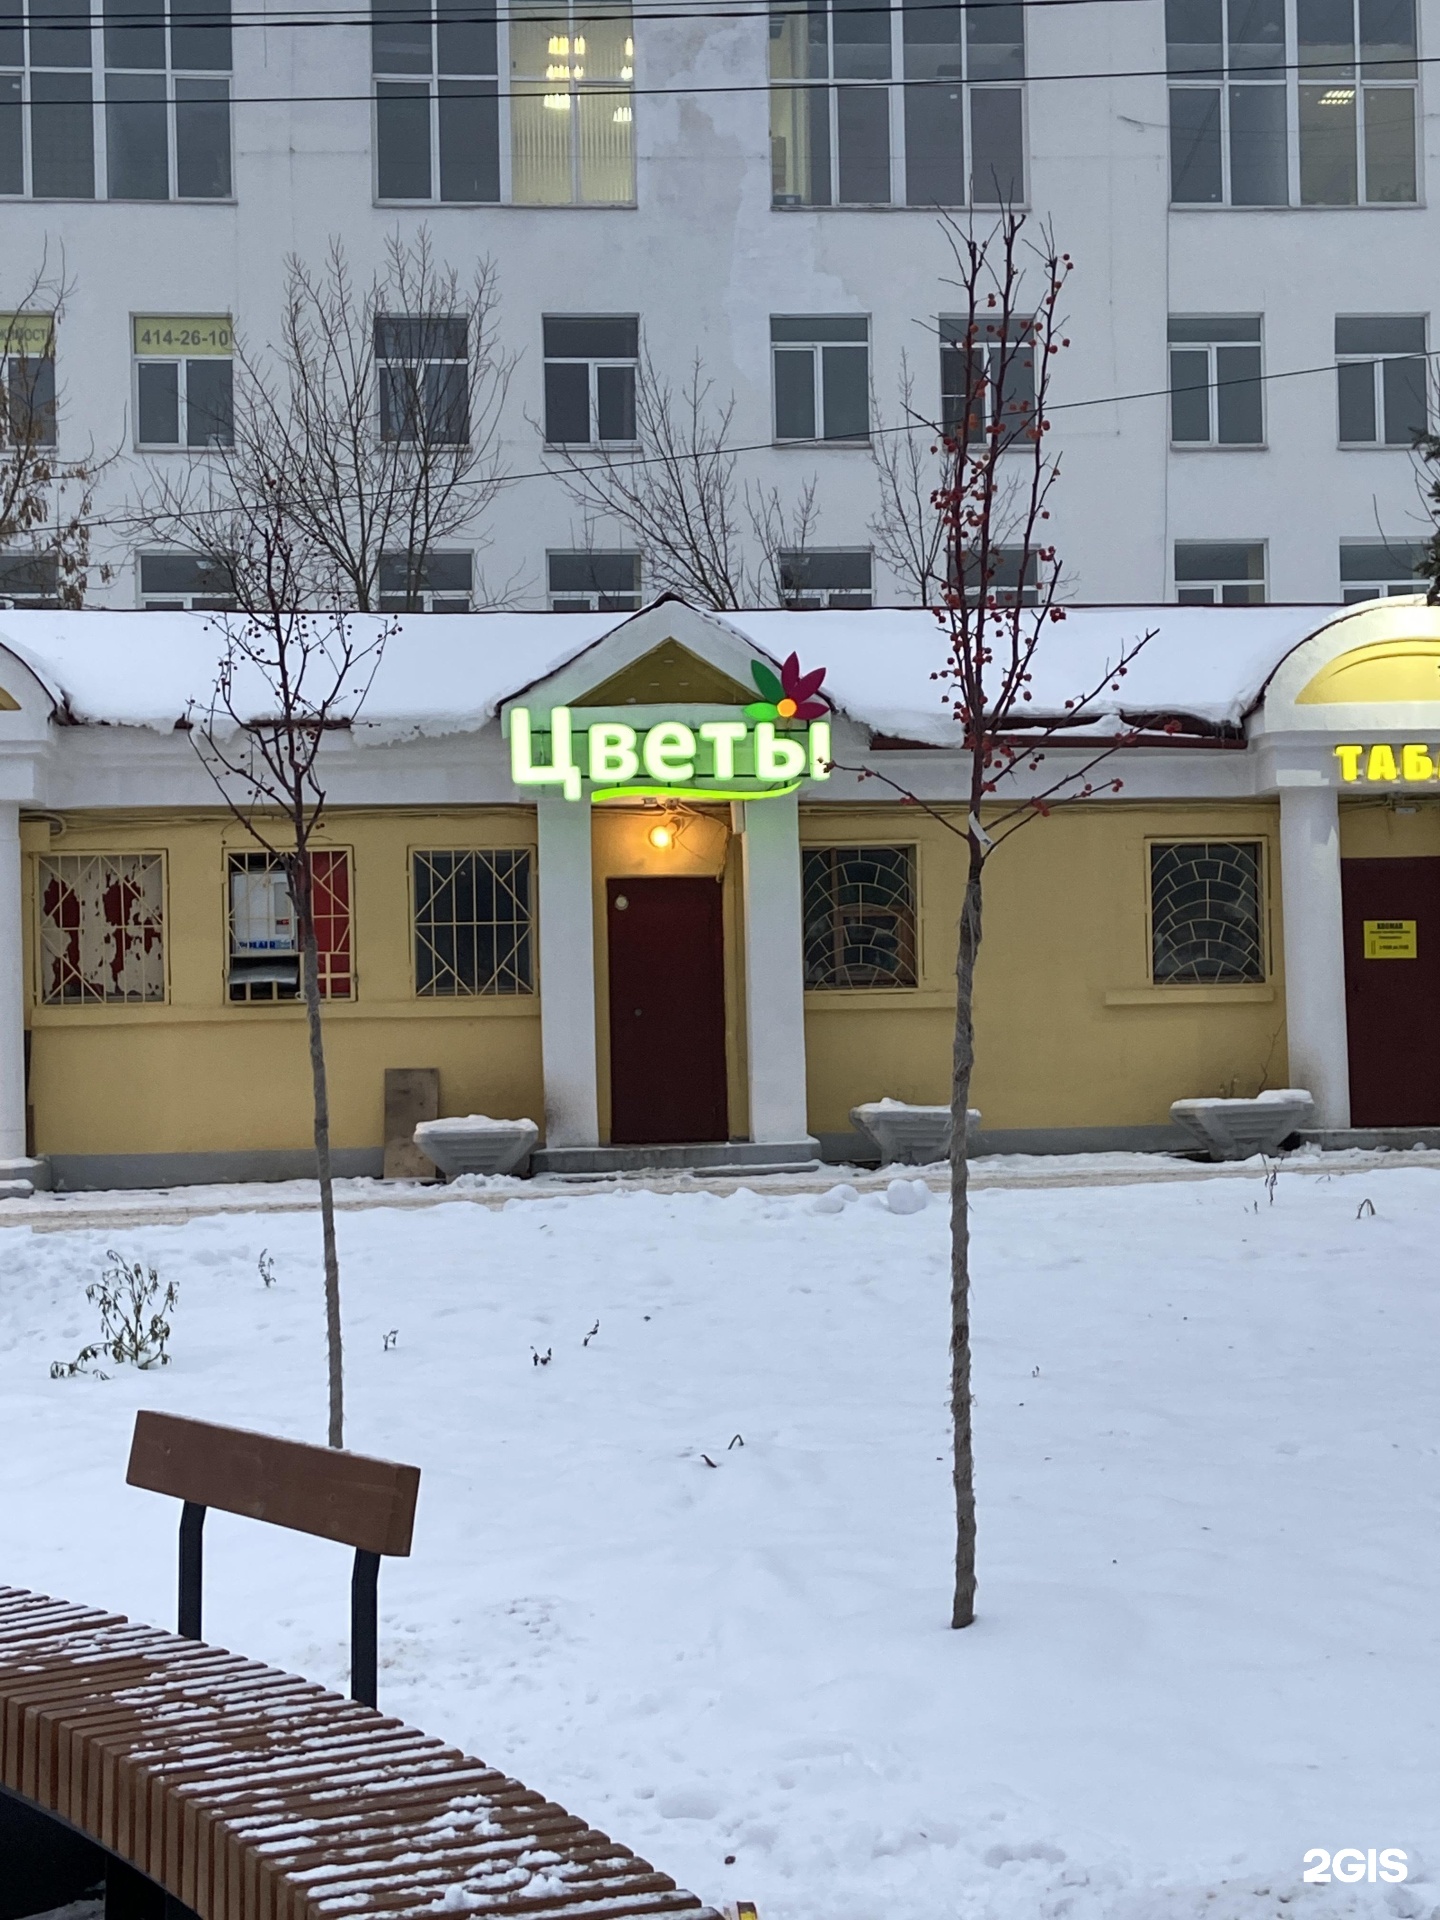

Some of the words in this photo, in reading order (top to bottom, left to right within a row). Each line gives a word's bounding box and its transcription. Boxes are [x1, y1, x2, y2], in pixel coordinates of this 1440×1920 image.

[141, 329, 229, 346] 414-26-10
[510, 706, 831, 800] Цветы
[1335, 743, 1440, 781] ТАБ
